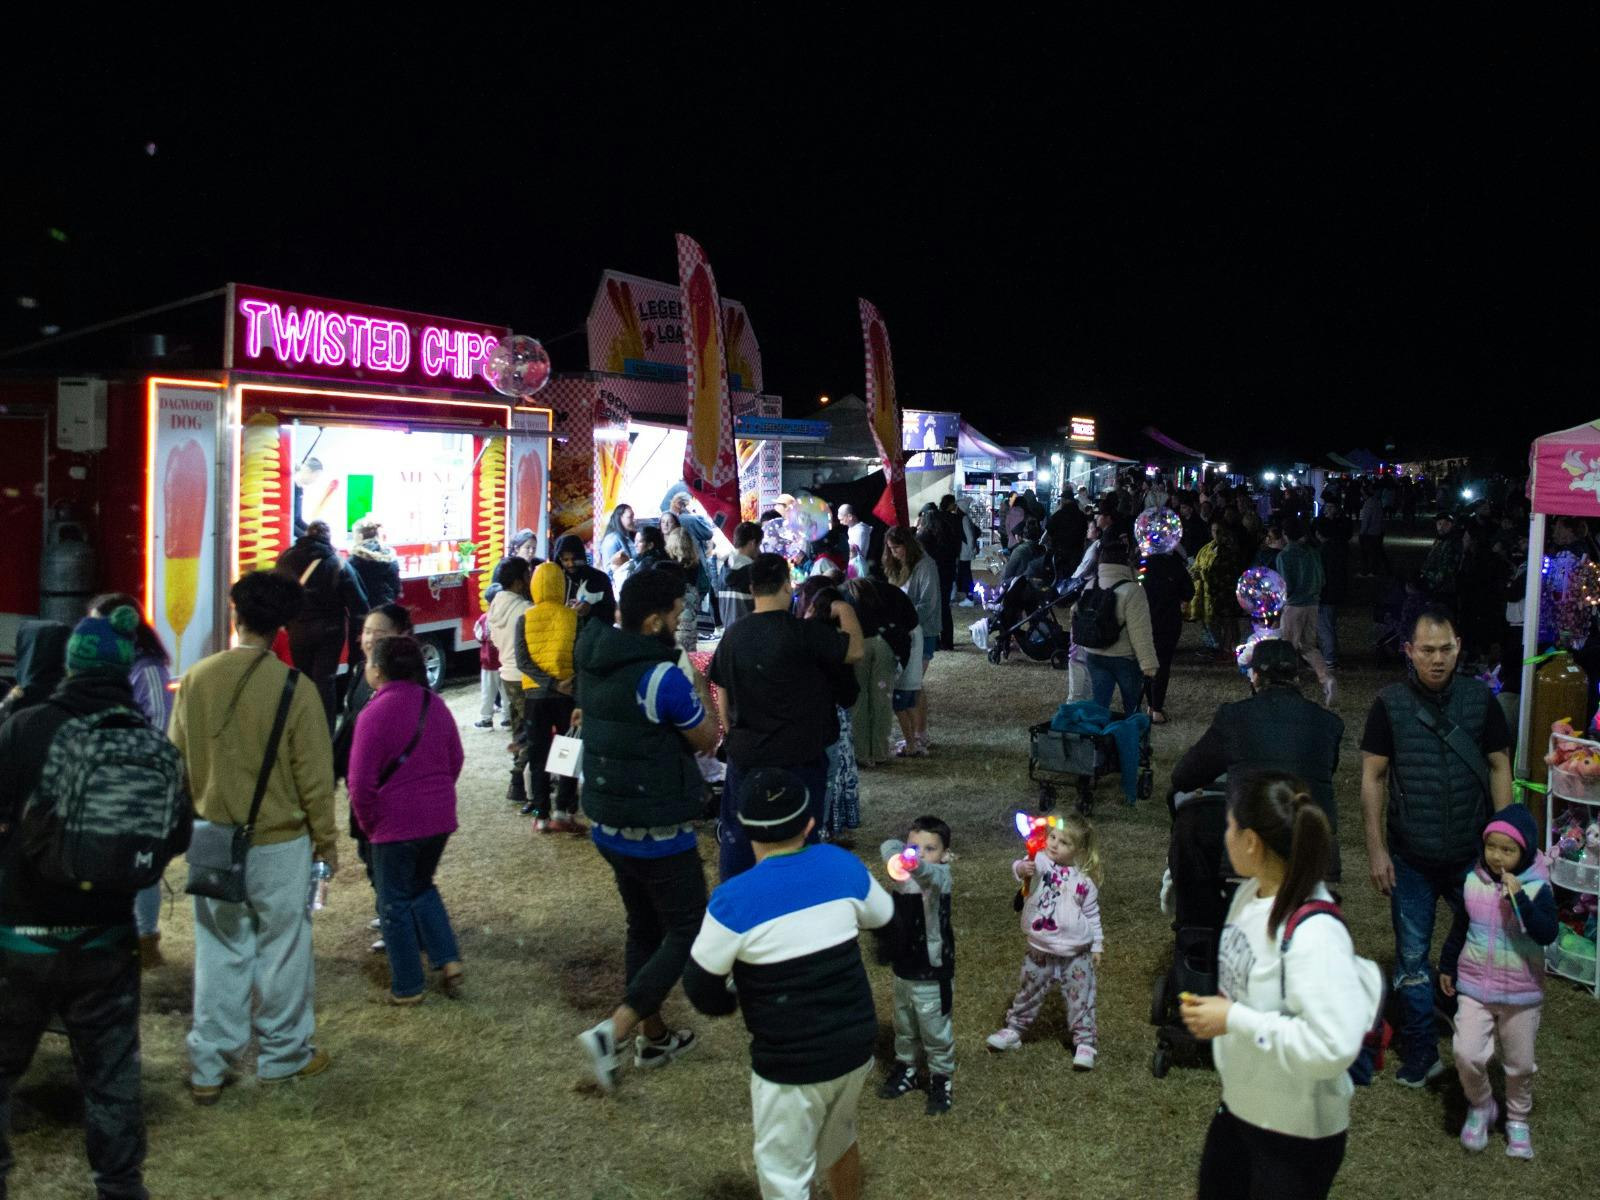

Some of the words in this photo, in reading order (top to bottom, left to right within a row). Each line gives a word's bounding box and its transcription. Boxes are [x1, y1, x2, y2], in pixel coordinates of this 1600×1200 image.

[240, 299, 411, 373] TWISTED
[159, 397, 214, 411] DAGWOOD
[170, 413, 203, 430] DOG
